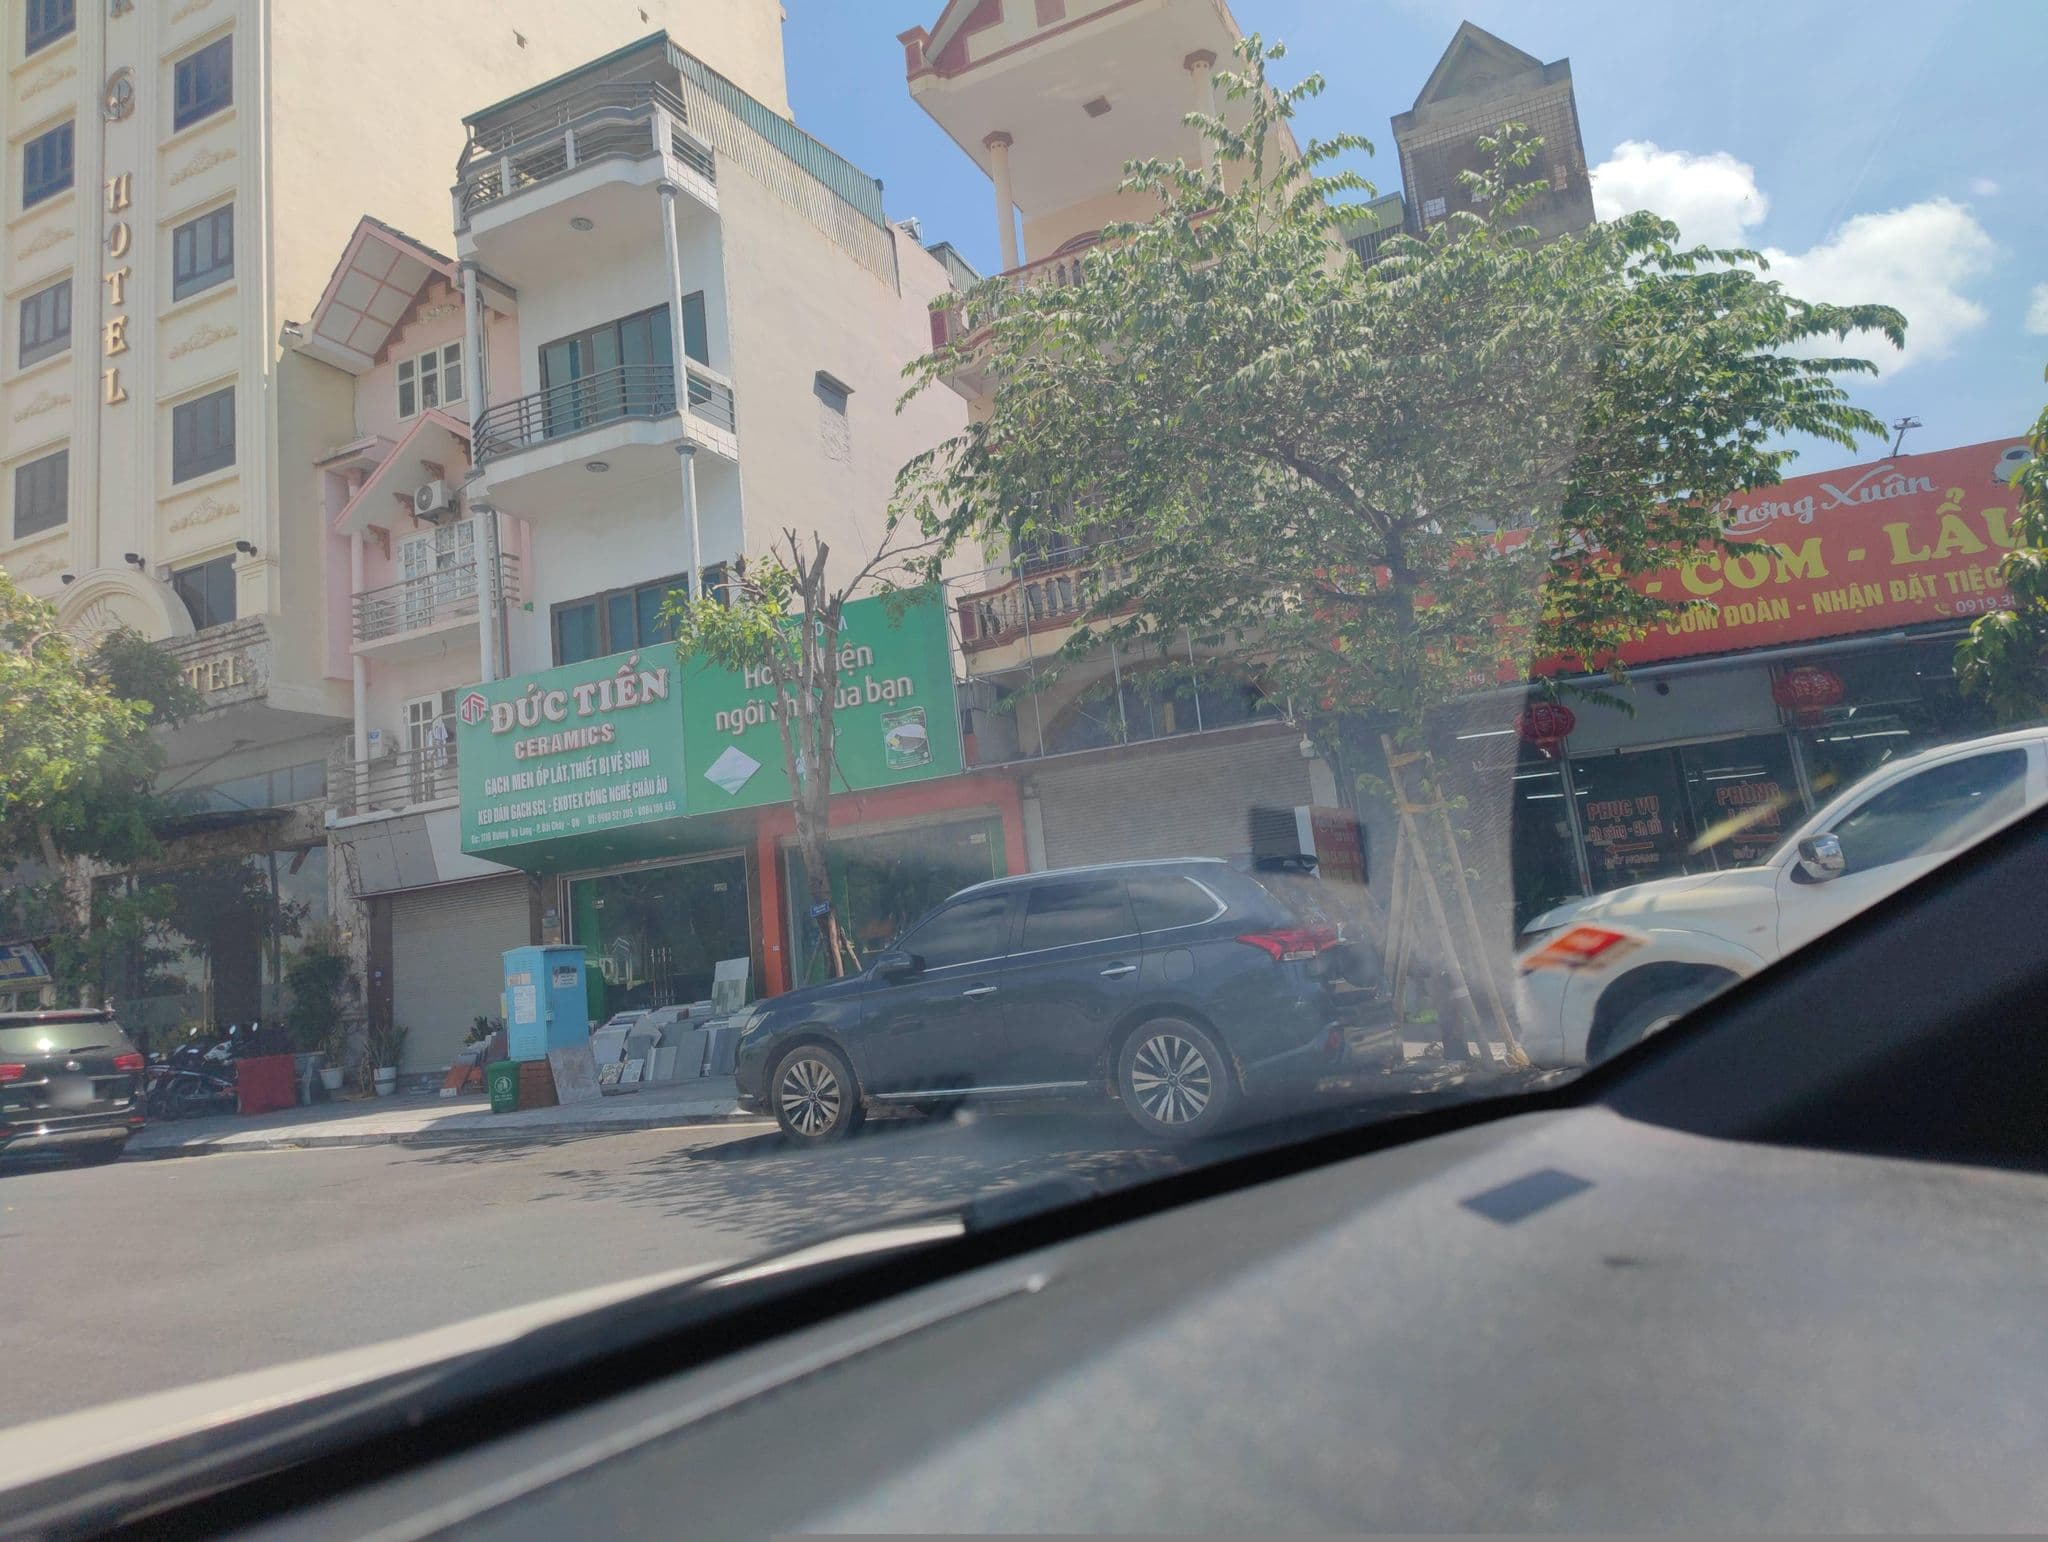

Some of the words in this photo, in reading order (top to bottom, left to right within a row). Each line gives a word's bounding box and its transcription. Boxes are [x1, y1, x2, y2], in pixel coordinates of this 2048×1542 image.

[104, 172, 132, 405] HOTEL
[1819, 465, 1938, 510] Xuân
[1681, 537, 1829, 596] CƠM
[1724, 596, 1790, 628] ĐOÀN
[1812, 582, 1884, 616] NHẬN
[1890, 573, 1938, 605] ĐẶT
[1944, 563, 2003, 597] TIỆC
[490, 683, 569, 735] ĐỨC
[573, 654, 670, 716] TIẾN
[716, 699, 766, 735] ngôi
[866, 675, 914, 707] bạn
[514, 722, 616, 760] CERAMICS
[485, 776, 510, 797] GẠCH
[512, 771, 534, 790] MEN
[536, 765, 550, 787] ỐP
[570, 755, 597, 779] THIẾT
[599, 758, 611, 777] BỊ
[611, 751, 624, 774] VỆ
[624, 749, 650, 770] SINH
[585, 786, 608, 807] CÔNG
[609, 781, 632, 803] NGHỆ
[632, 778, 655, 799] CHÂU
[656, 775, 668, 796] ÂU
[1586, 800, 1632, 823] PHỤC
